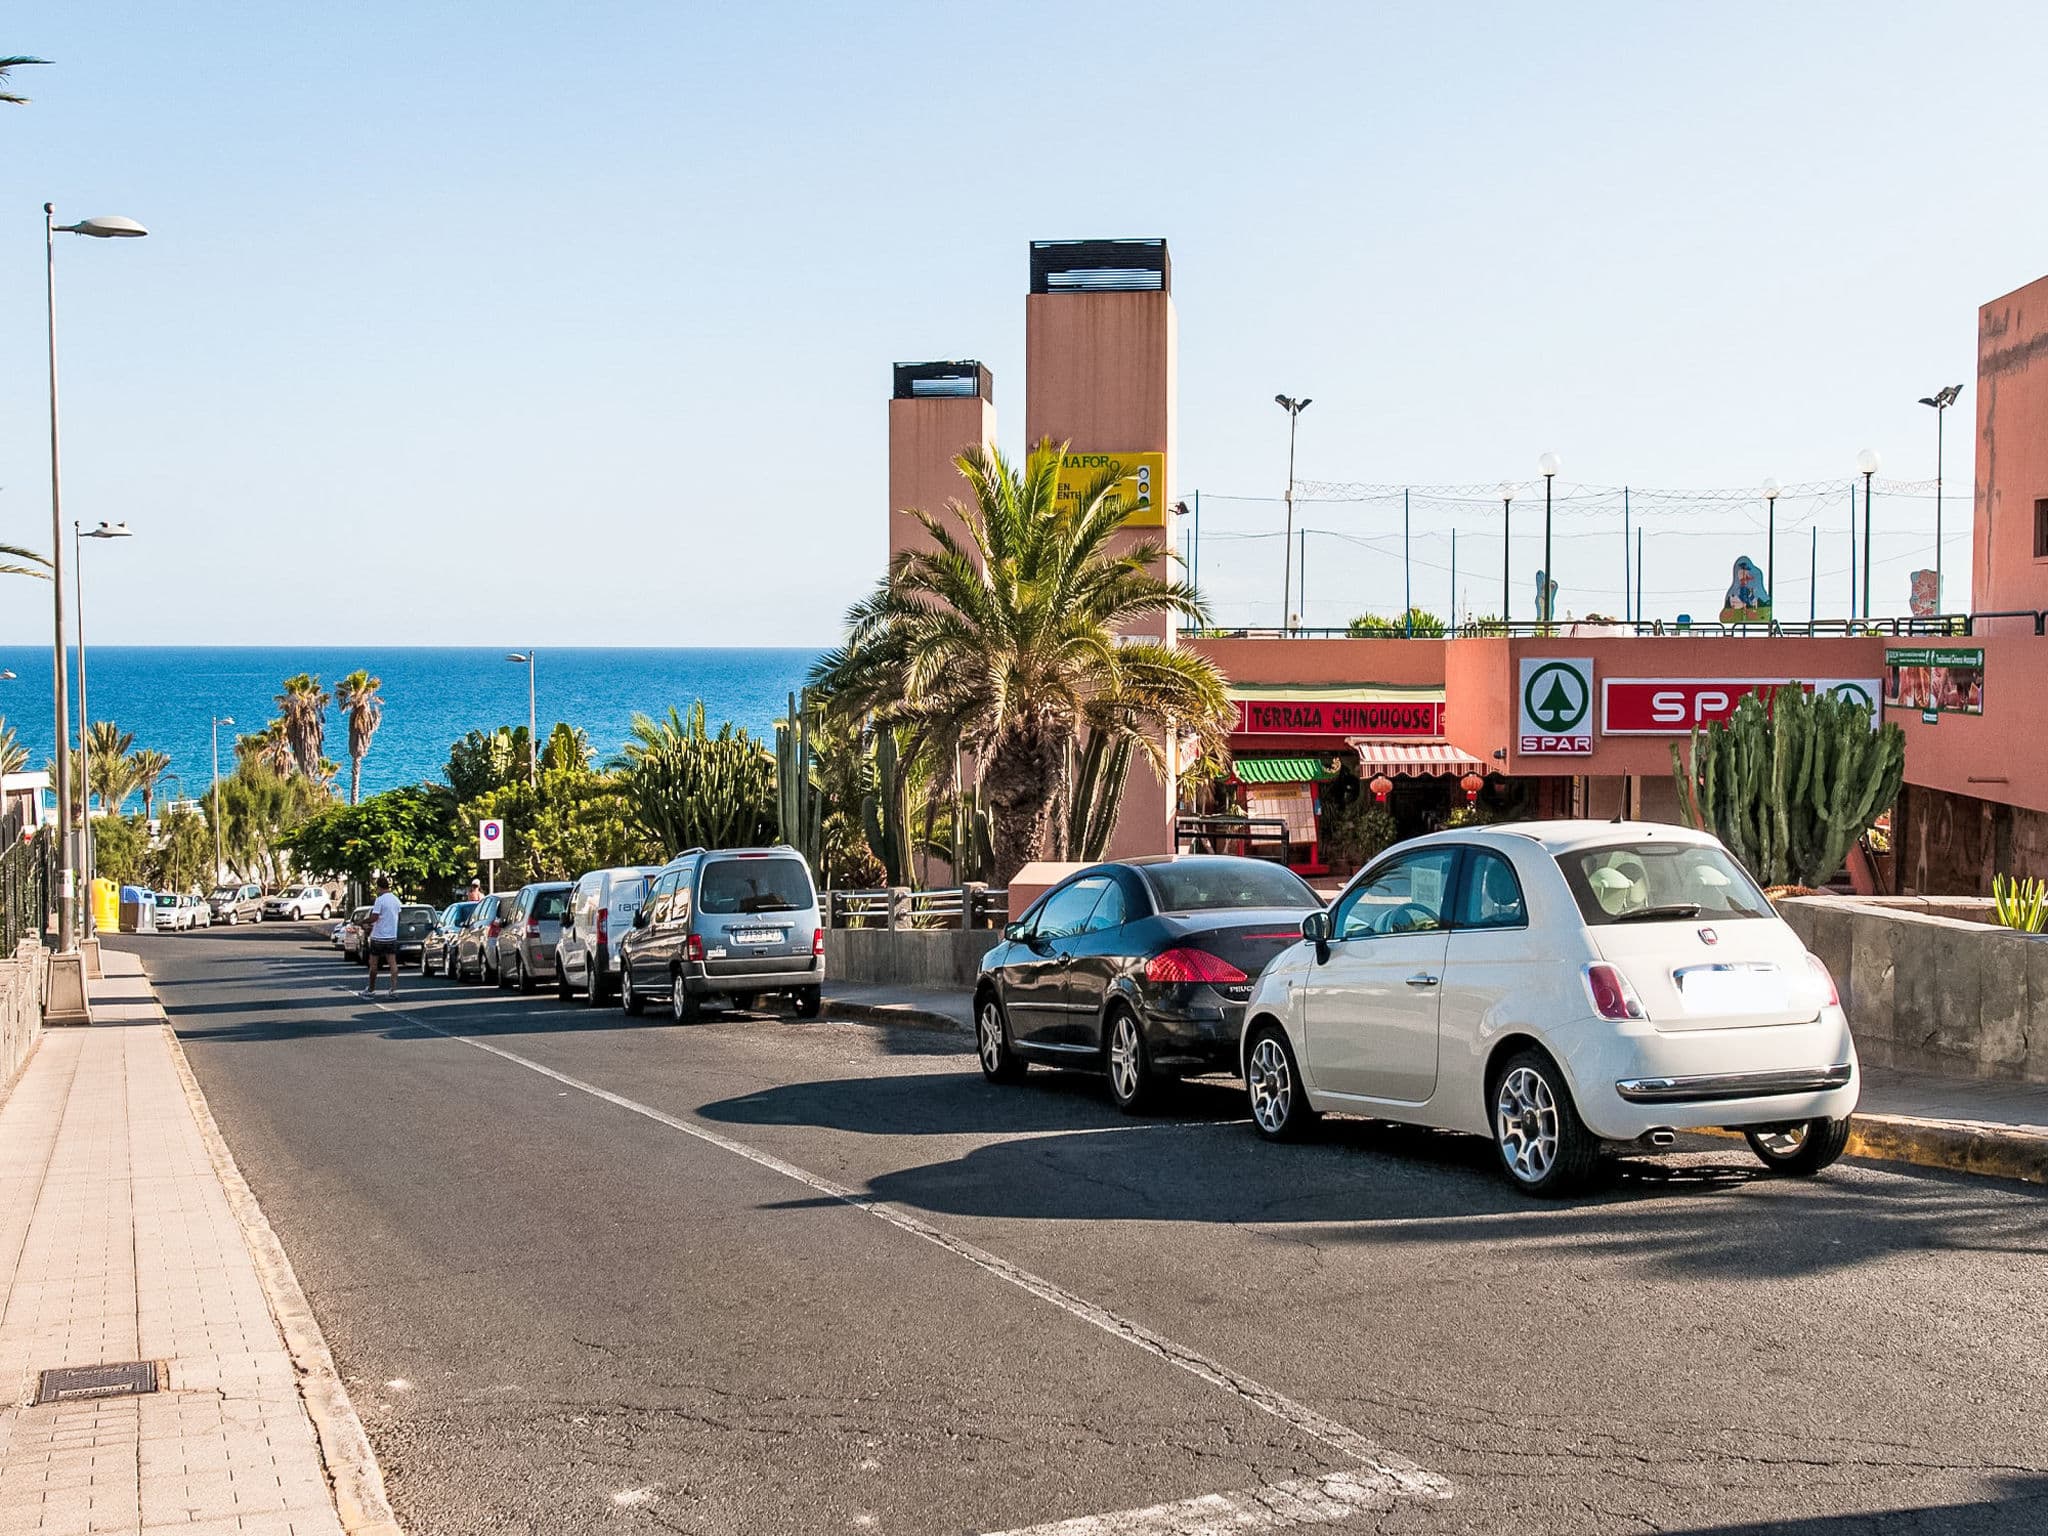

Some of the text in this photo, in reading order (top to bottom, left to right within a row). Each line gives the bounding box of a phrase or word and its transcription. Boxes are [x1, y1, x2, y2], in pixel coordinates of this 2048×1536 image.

[1252, 707, 1322, 728] TERRAZA
[1332, 708, 1430, 729] CHINOHOUSE
[1522, 737, 1591, 751] SPAR
[618, 901, 642, 912] rad
